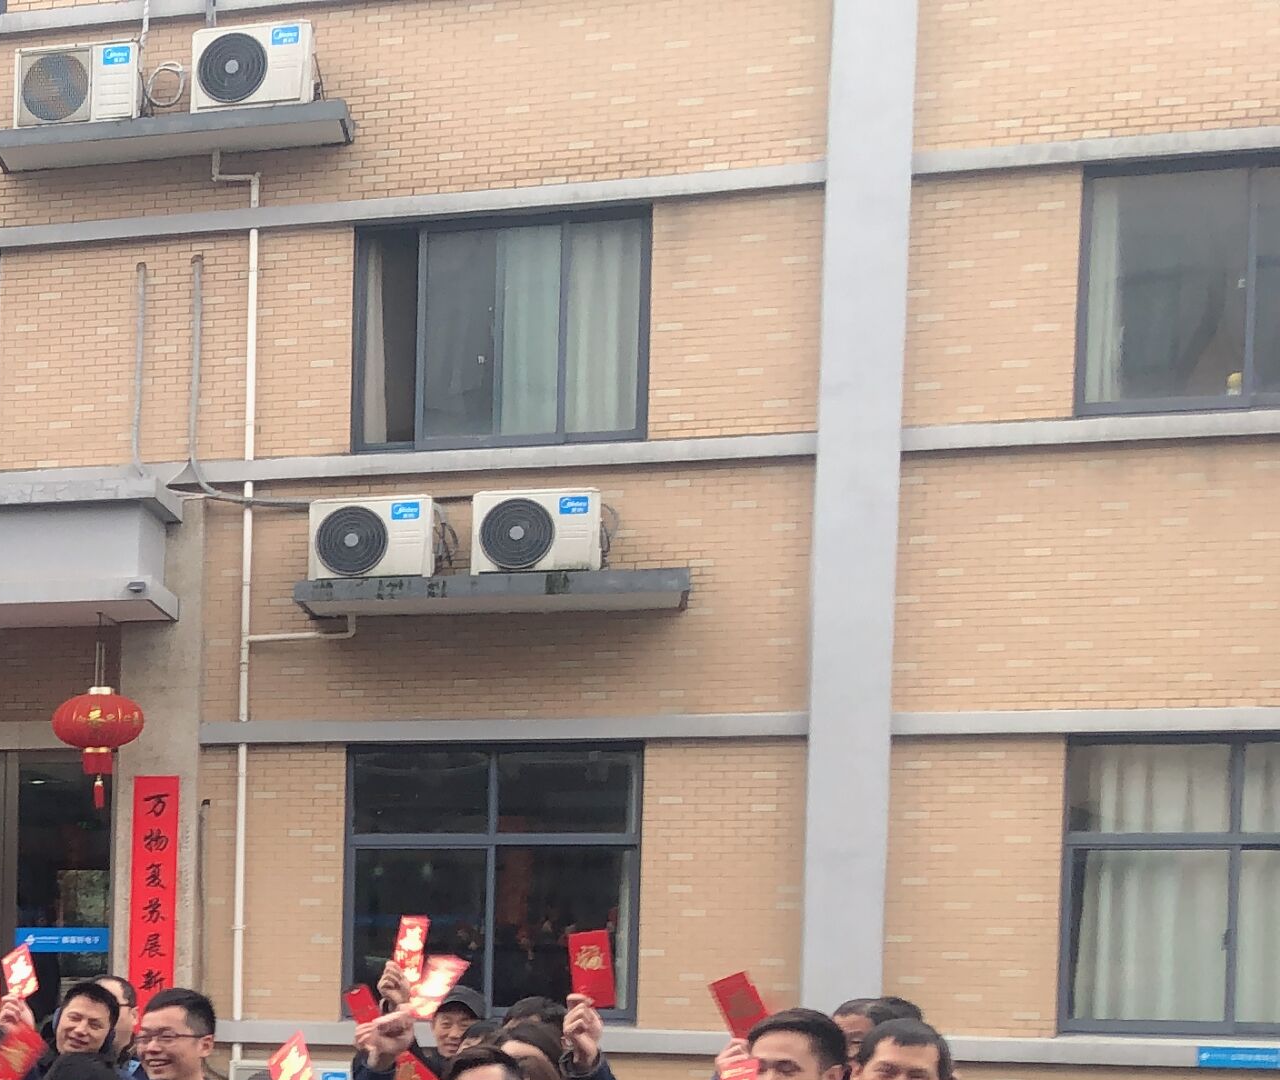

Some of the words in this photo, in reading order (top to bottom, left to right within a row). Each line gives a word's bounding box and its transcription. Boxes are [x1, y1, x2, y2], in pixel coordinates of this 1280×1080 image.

[138, 793, 169, 991] 万物复苏展新
